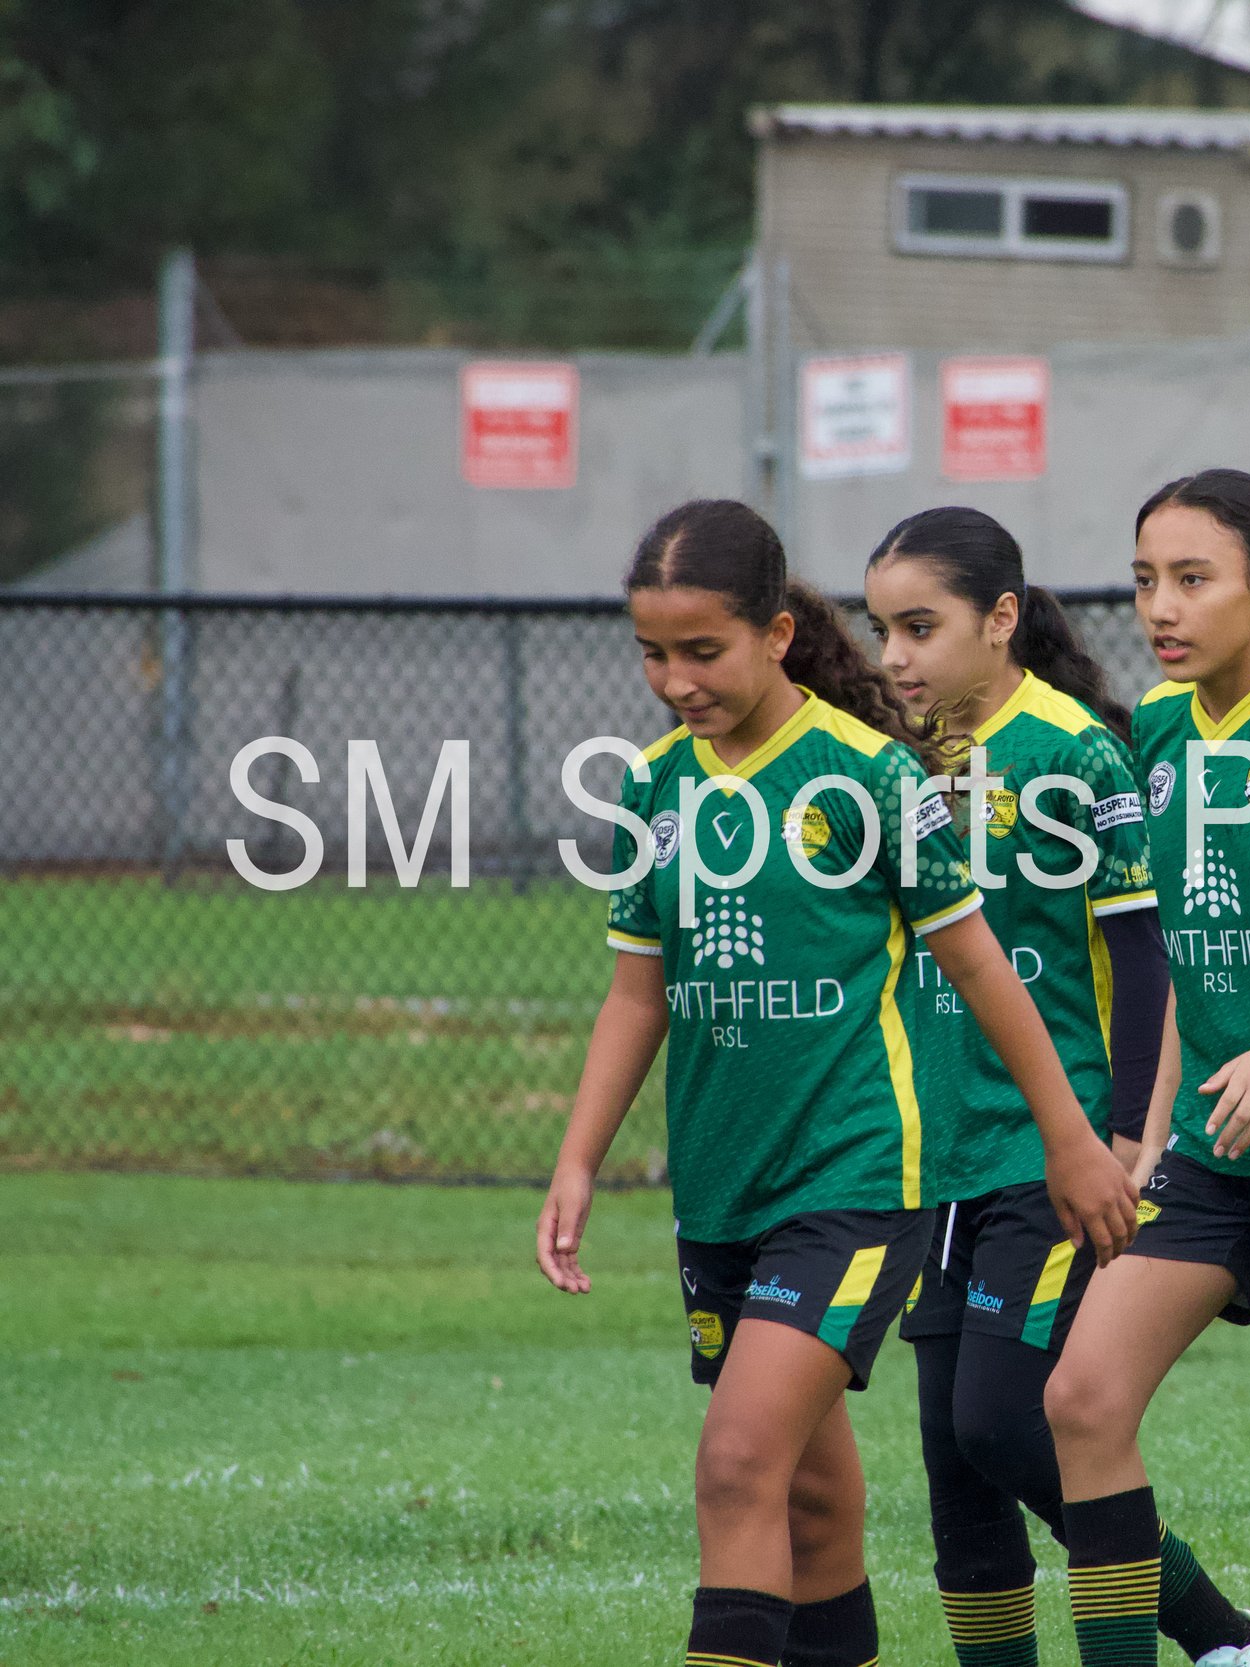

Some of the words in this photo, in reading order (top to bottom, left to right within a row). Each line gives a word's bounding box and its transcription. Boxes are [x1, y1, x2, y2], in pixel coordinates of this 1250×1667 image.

[1107, 816, 1116, 824] TO
[1203, 972, 1238, 993] RSL
[936, 993, 963, 1014] RSL
[712, 1026, 748, 1048] RSL
